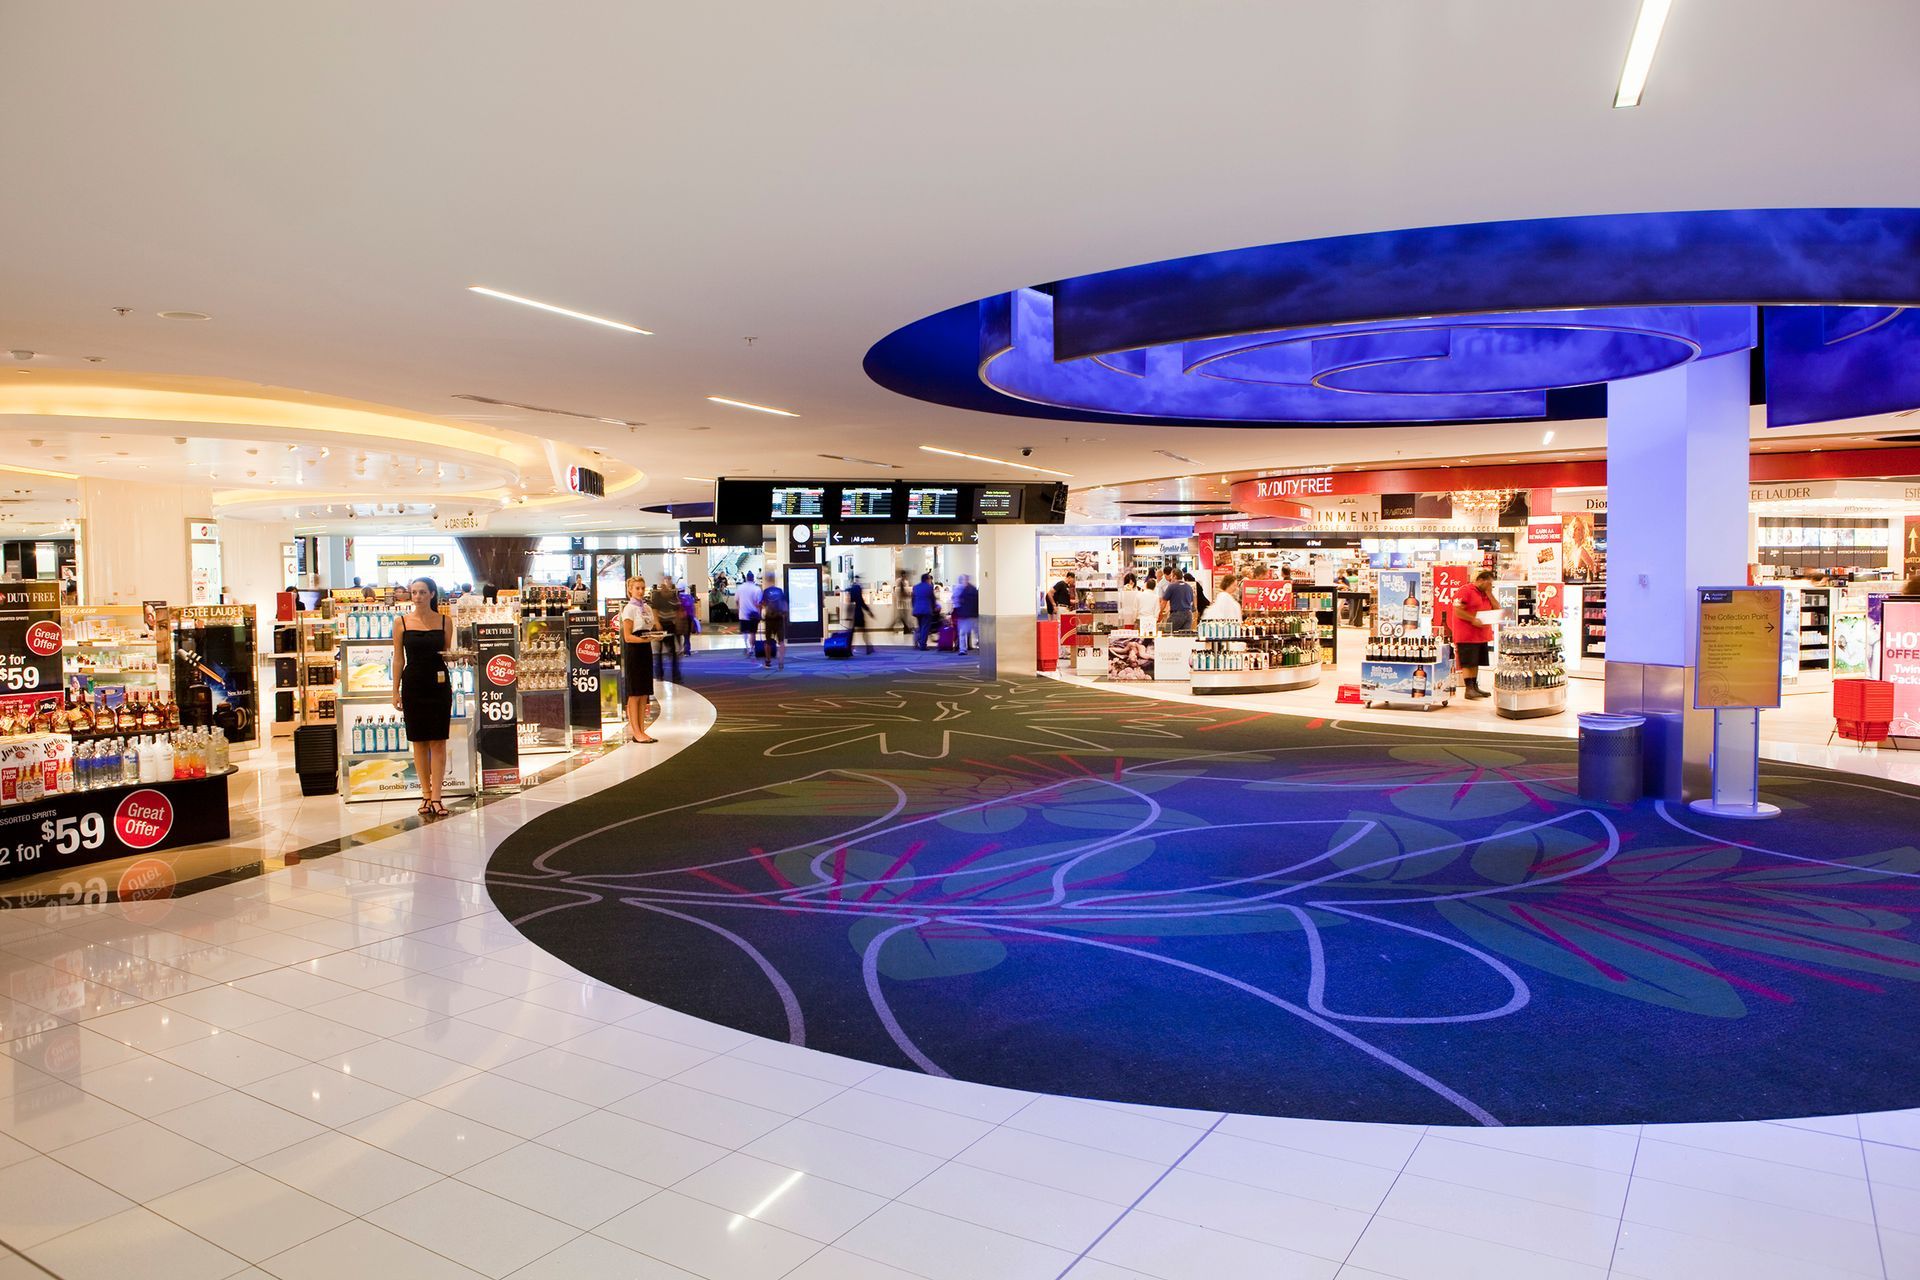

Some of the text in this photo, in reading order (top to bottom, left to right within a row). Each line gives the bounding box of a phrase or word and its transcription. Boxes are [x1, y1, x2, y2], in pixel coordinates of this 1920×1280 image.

[1766, 487, 1811, 500] LAUDER
[449, 518, 474, 529] CASHIERS
[1440, 571, 1449, 585] 2
[7, 591, 56, 603] DUTY FREE
[183, 606, 244, 617] ESTEE LAUDER
[34, 627, 60, 641] Great
[499, 627, 513, 635] FREE
[33, 638, 57, 650] Offer
[0, 654, 27, 665] 2 for
[0, 666, 40, 690] $59
[572, 668, 590, 676] 2 for
[572, 676, 598, 692] $69
[481, 691, 503, 700] 2 for
[481, 701, 514, 721] $69
[32, 809, 57, 820] SPIRITS
[127, 802, 166, 821] Great
[125, 819, 160, 837] Offer
[0, 812, 105, 866] 2 for $59
